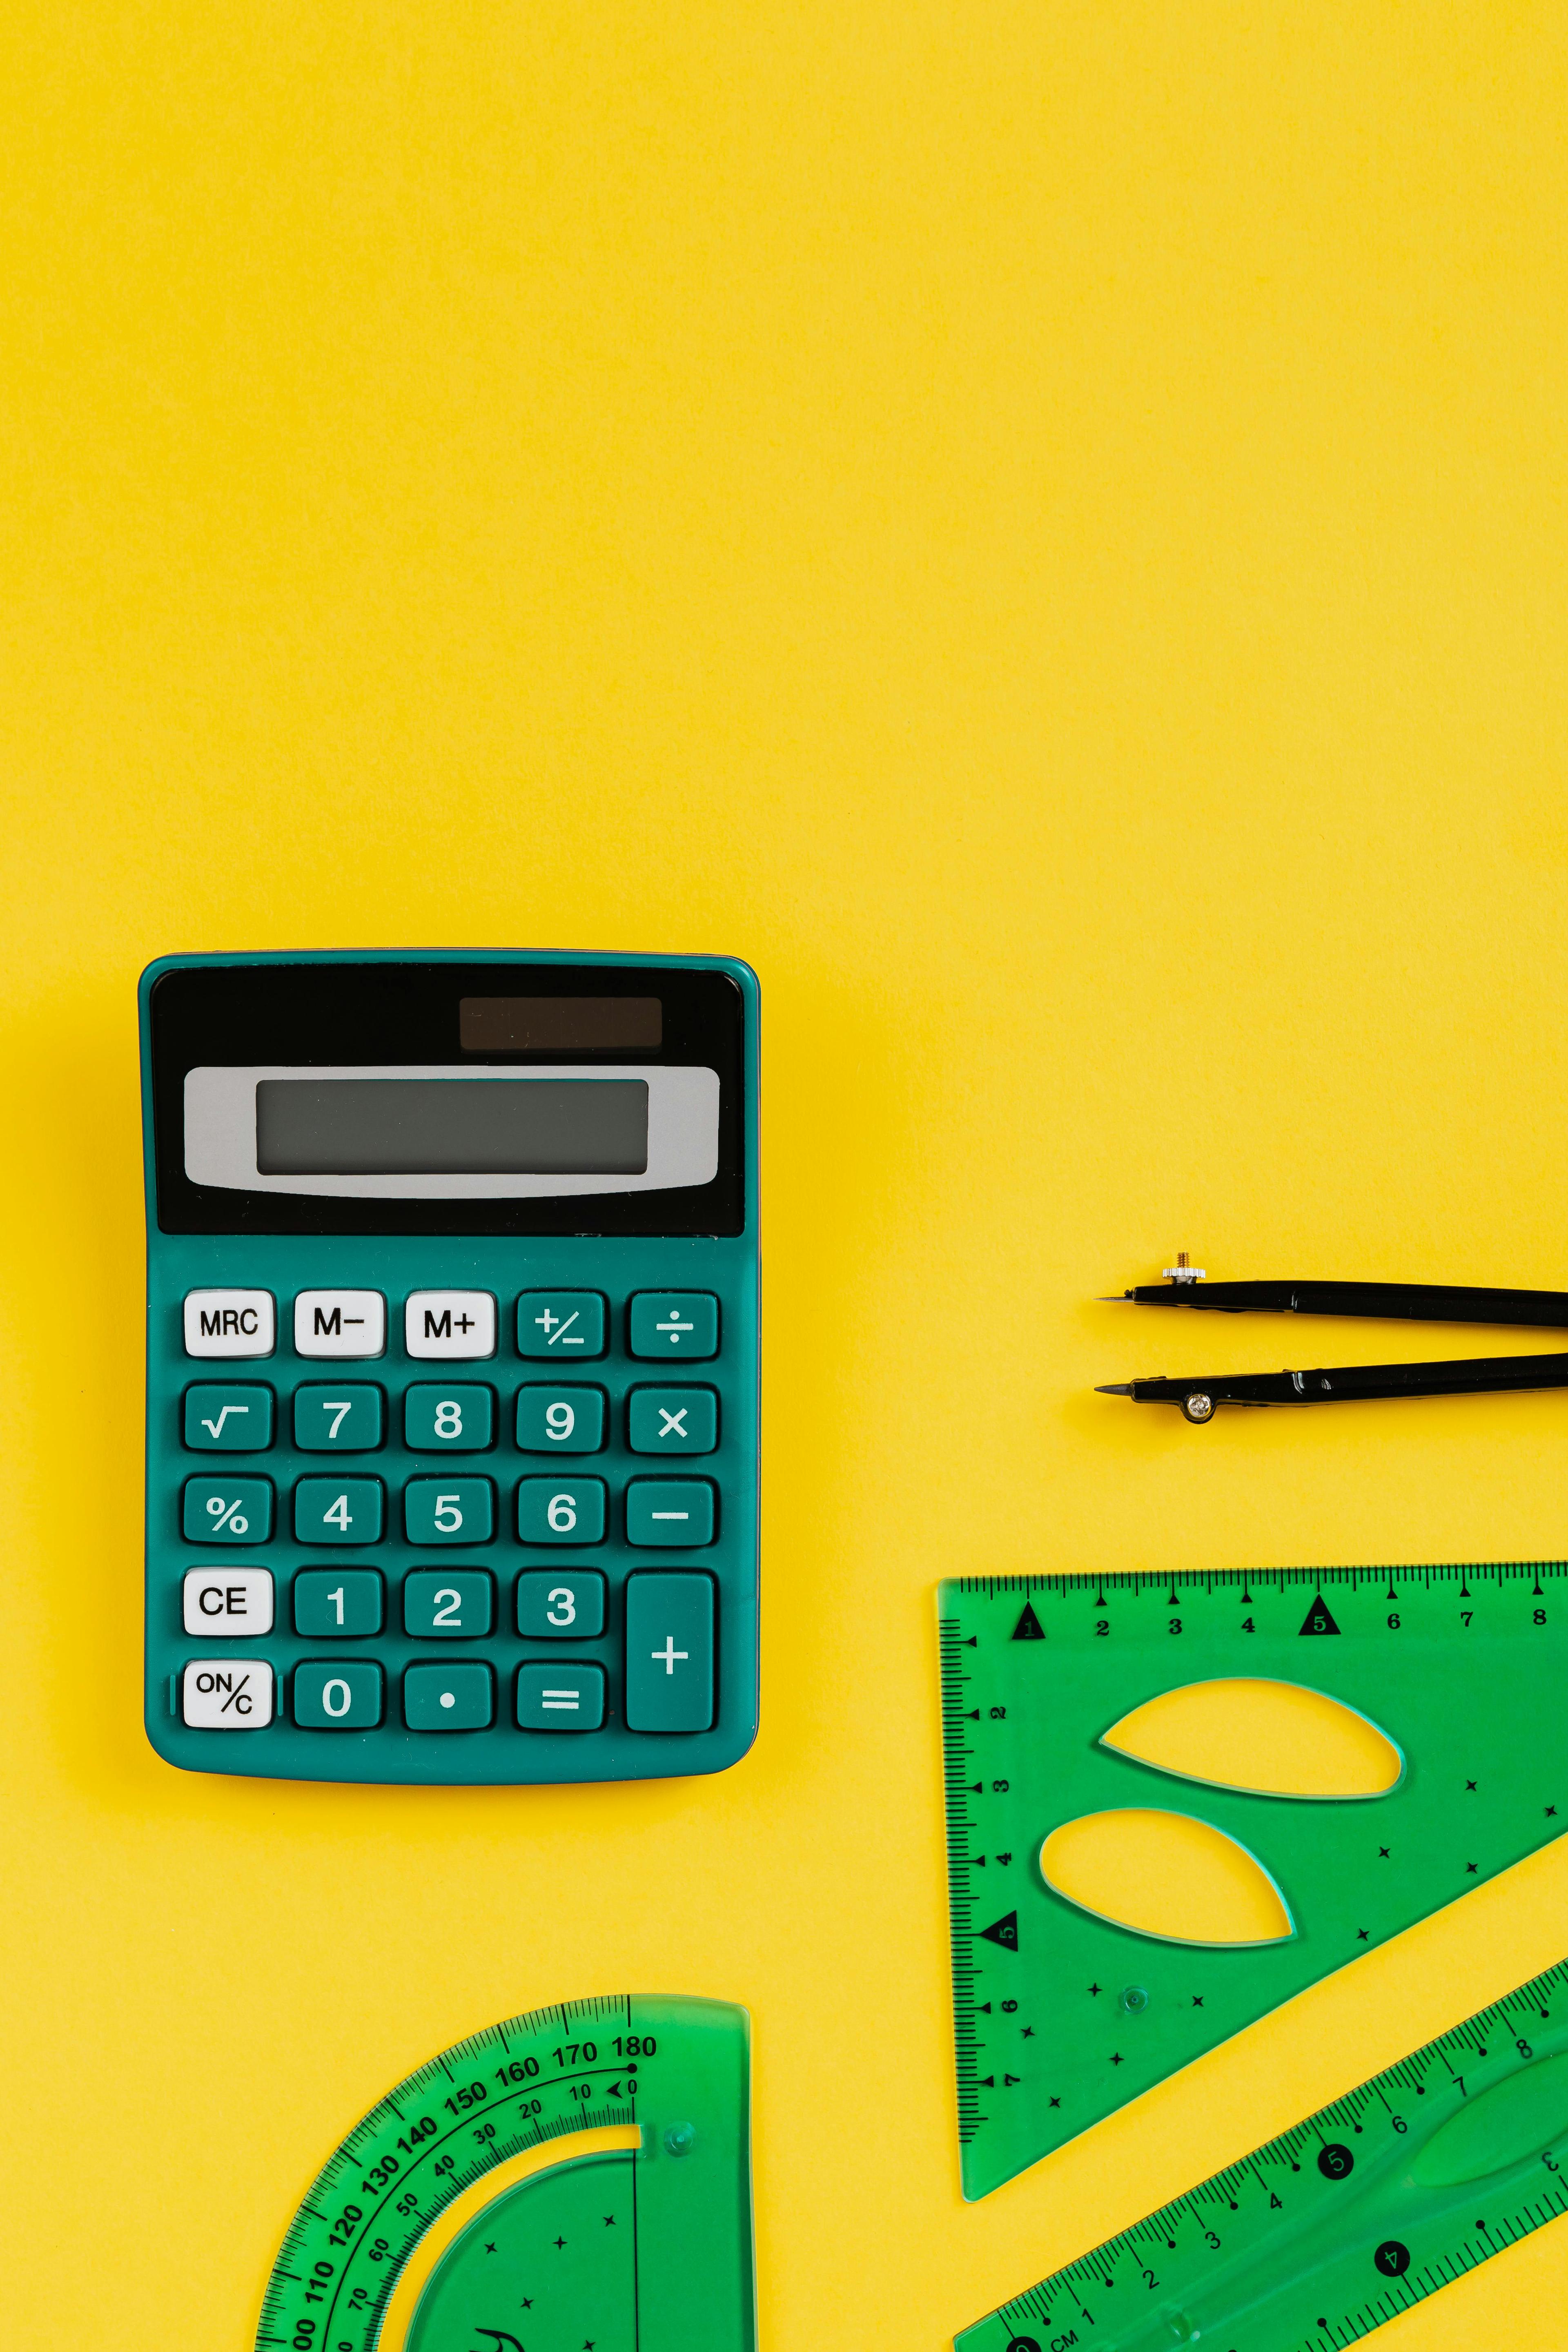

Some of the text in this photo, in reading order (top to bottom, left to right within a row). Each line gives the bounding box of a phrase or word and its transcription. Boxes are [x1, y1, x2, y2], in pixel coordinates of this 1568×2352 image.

[200, 1308, 258, 1336] MRC
[424, 1310, 475, 1338] M+
[323, 1402, 351, 1438] 7
[434, 1401, 463, 1439] 8
[546, 1402, 575, 1440] 9
[323, 1495, 353, 1531] 4
[434, 1495, 463, 1532] 5
[547, 1494, 577, 1532] 6
[199, 1587, 247, 1616] CE
[327, 1587, 344, 1625] 1
[433, 1589, 461, 1626] 2
[547, 1588, 576, 1626] 3
[1025, 1609, 1547, 1636] 1 2 3 4 5 6 7 8
[322, 1679, 351, 1717] 0
[990, 1706, 1020, 2087] 2 3 4 5 6 7
[292, 2036, 657, 2351] 00 110 120 130 140 150 160 170 180
[348, 2288, 368, 2310] 70
[368, 2238, 389, 2262] 60
[396, 2193, 418, 2216] 50
[434, 2155, 454, 2177] 40
[473, 2123, 496, 2145] 30
[519, 2099, 542, 2120] 20
[569, 2084, 591, 2101] 10
[628, 2079, 637, 2094] 0
[1082, 2039, 1533, 2325] 1 2 3 4 5 6 7 8
[1384, 2251, 1398, 2270] 4
[1050, 2330, 1079, 2352] CM
